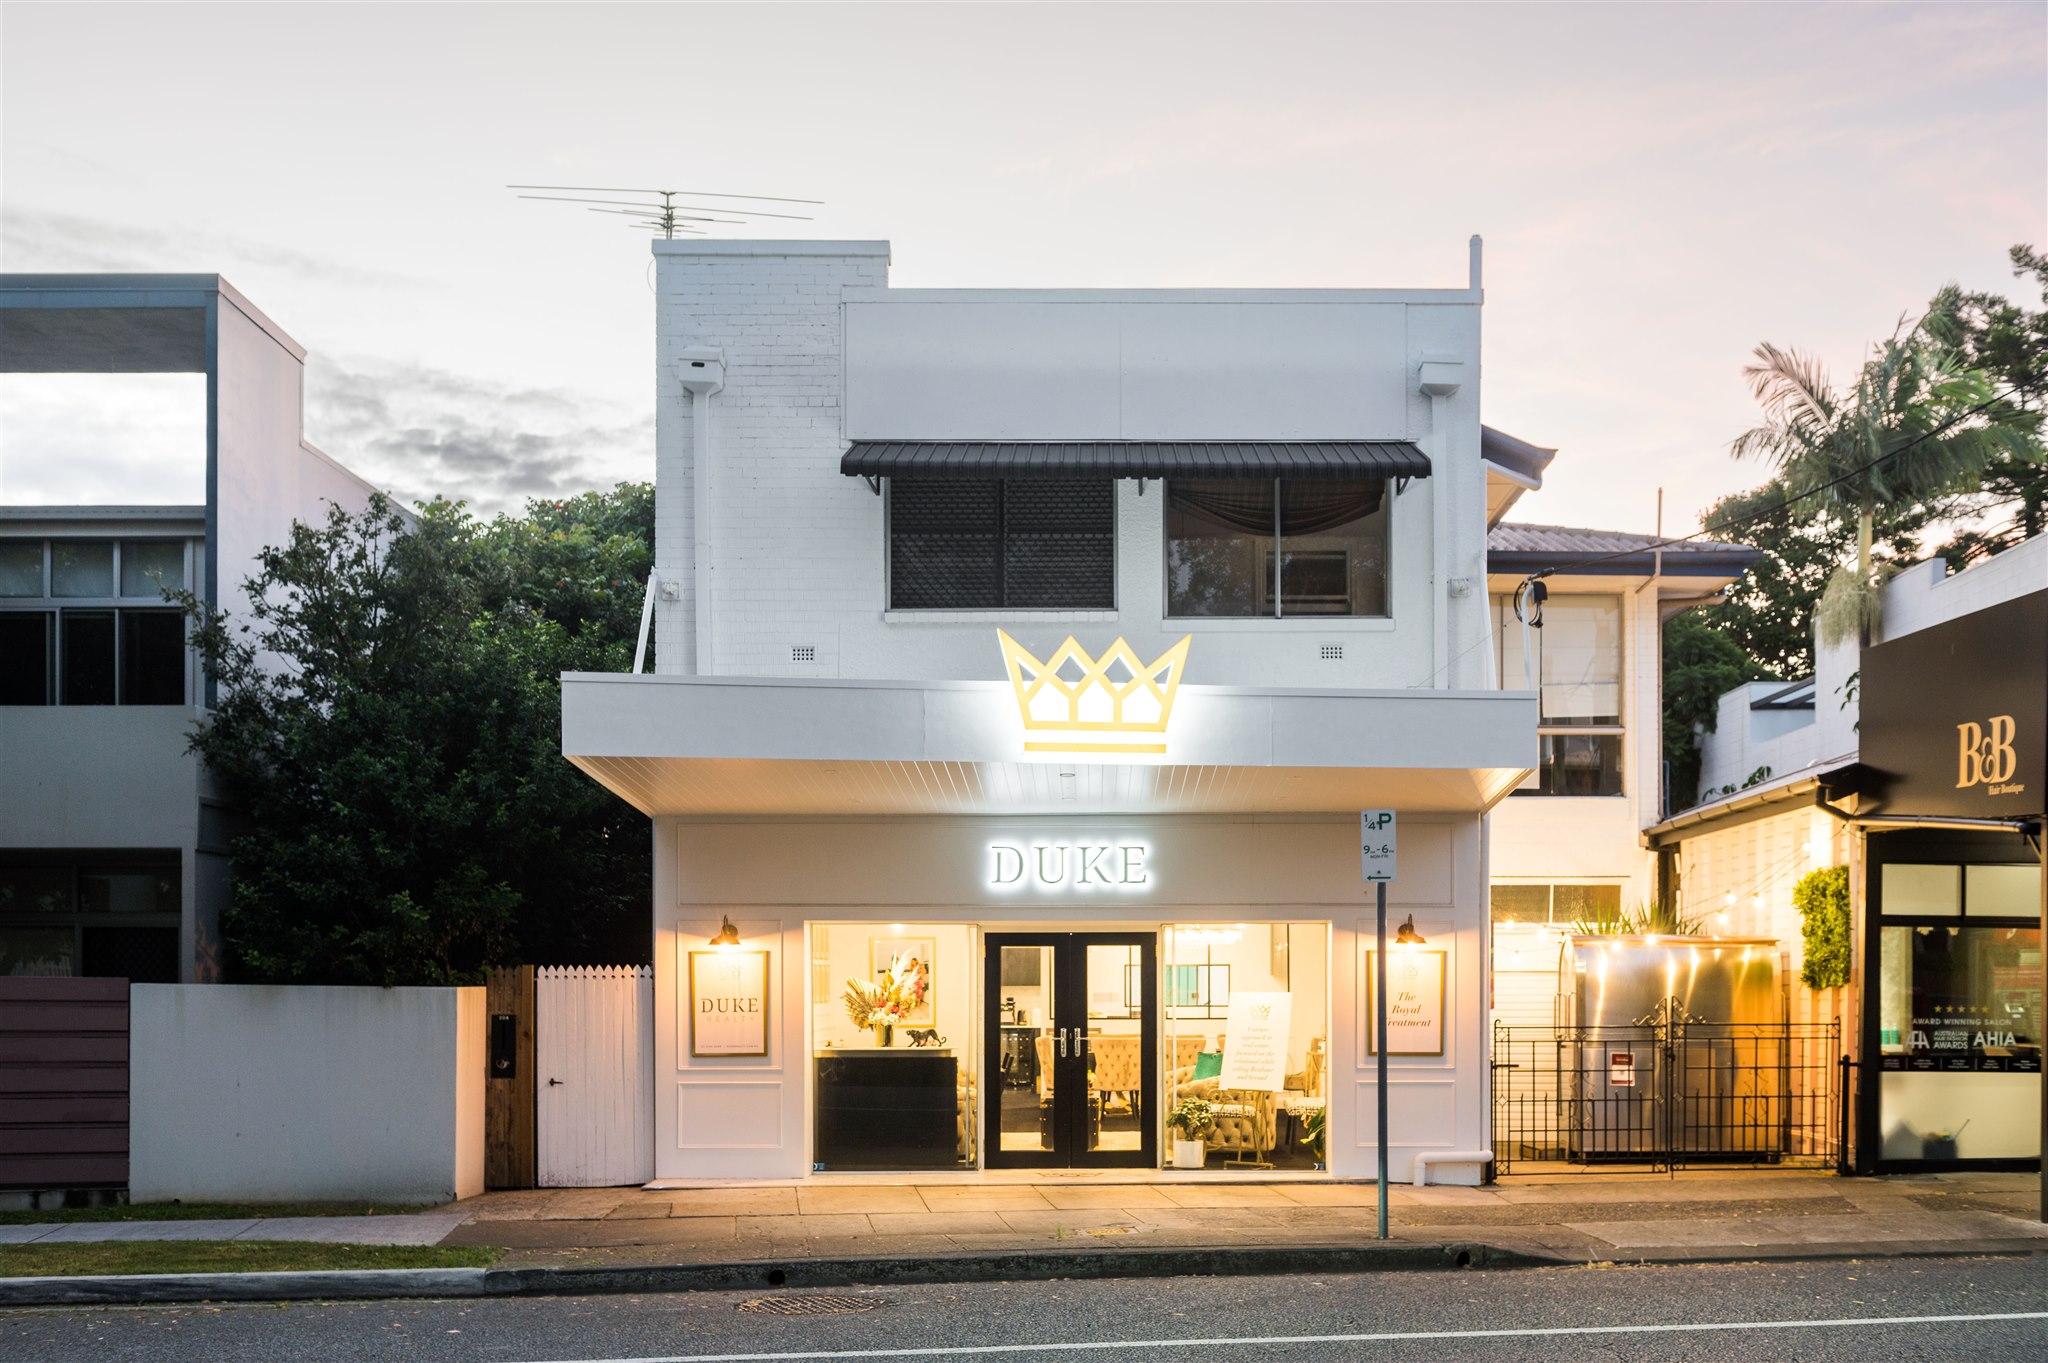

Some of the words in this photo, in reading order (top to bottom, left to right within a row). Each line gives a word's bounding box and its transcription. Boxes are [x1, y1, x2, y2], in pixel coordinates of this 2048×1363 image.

[1955, 715, 2017, 789] B&B
[991, 846, 1147, 884] DUKE
[1398, 991, 1417, 1002] The
[700, 997, 759, 1013] DUKE
[1392, 1004, 1422, 1016] Royal
[1385, 1017, 1431, 1027] reatment
[1912, 1018, 1941, 1026] AWARD
[1944, 1018, 1982, 1026] WINNING
[1984, 1018, 2012, 1026] SALON
[1972, 1031, 2017, 1047] AHIA
[1933, 1041, 1969, 1050] AWARDS
